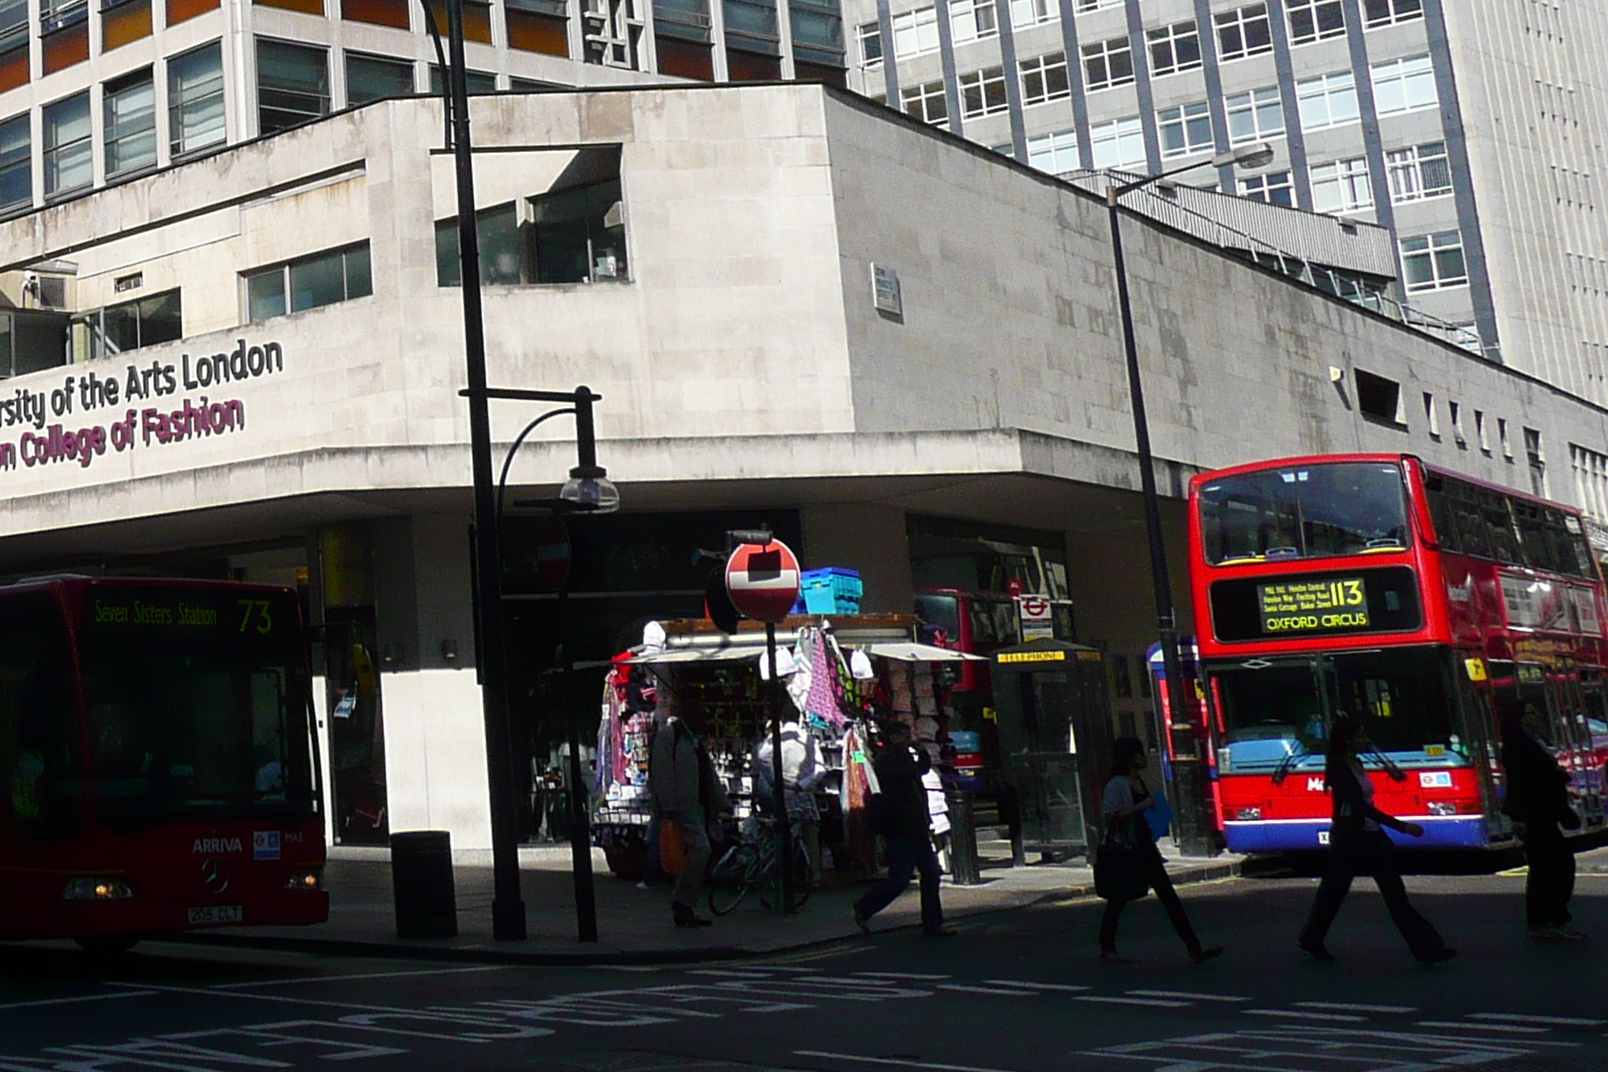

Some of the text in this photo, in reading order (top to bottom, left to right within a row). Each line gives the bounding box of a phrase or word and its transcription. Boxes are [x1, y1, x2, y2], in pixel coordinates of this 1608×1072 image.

[51, 377, 76, 416] of
[79, 372, 120, 409] the
[125, 360, 176, 402] Arts
[182, 339, 284, 390] London
[20, 423, 107, 469] College
[111, 409, 138, 452] of
[142, 397, 245, 446] Fashion
[1330, 580, 1363, 606] 113
[94, 598, 218, 626] Seven Sisters Station
[237, 598, 273, 634] 73
[1266, 613, 1367, 630] OXFORD CIRCUS
[192, 837, 243, 854] ARRIVA
[191, 906, 238, 921] 205 CLT
